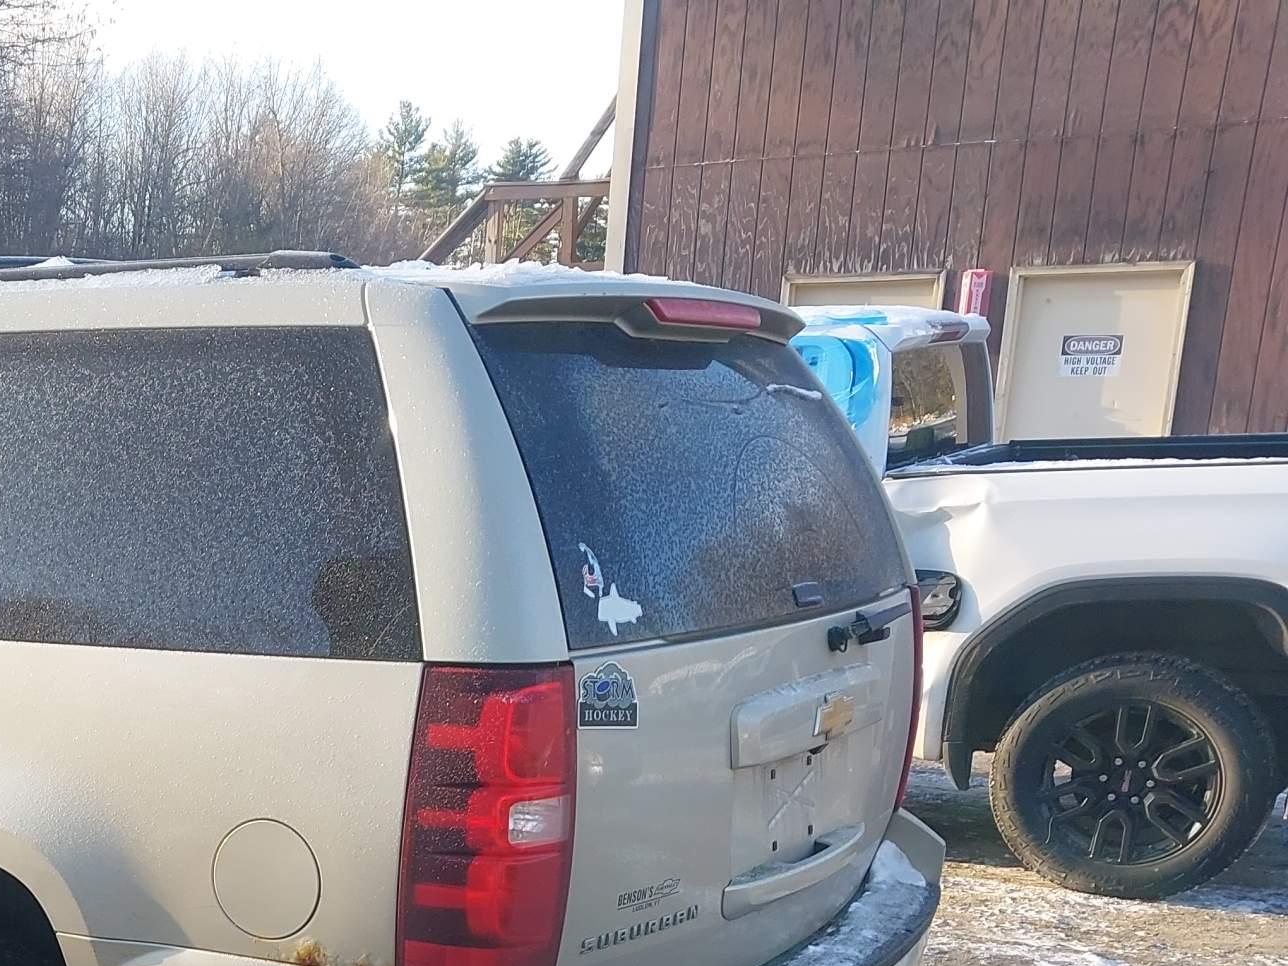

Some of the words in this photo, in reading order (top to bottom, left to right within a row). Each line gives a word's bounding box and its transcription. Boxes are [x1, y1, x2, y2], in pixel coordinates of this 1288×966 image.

[1070, 340, 1114, 351] DANGER
[1064, 356, 1082, 365] HIGH
[1086, 356, 1116, 365] VOLTAGE
[1070, 366, 1089, 375] KEEP
[1092, 366, 1107, 375] OUT
[584, 709, 633, 721] HOCKEY
[617, 885, 654, 907] BENSON'S
[579, 904, 699, 955] SUBURBAN
